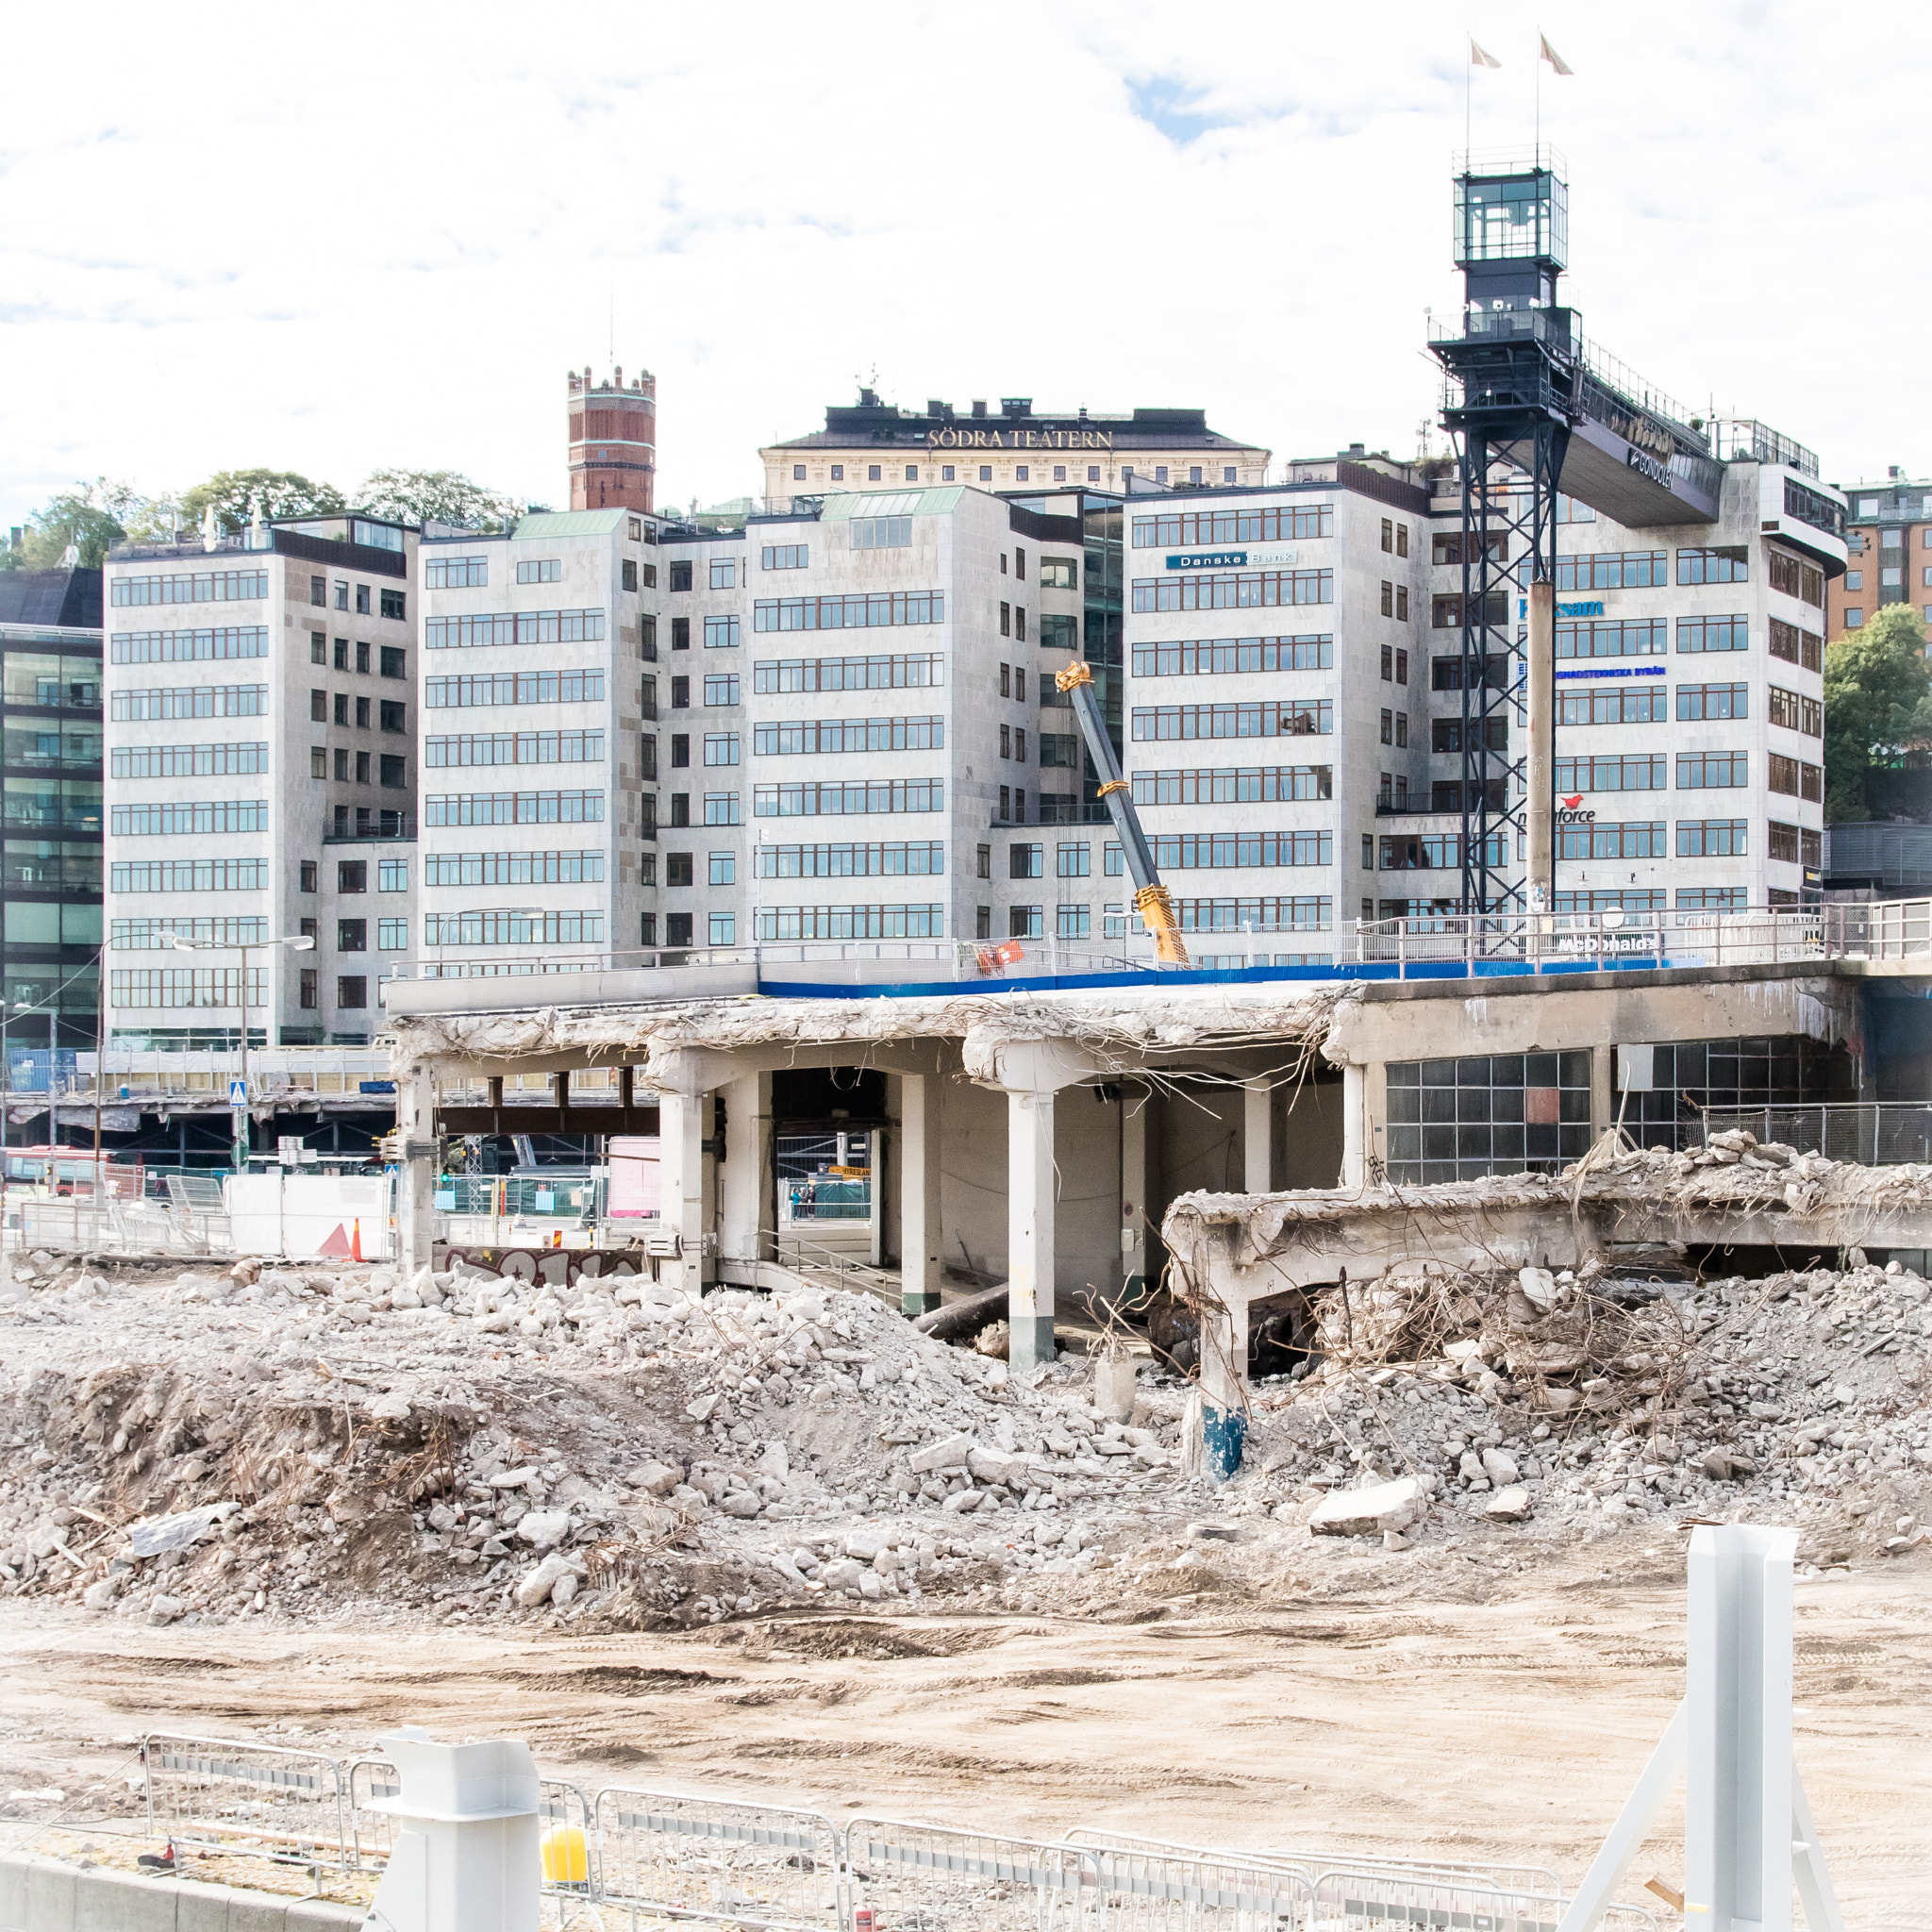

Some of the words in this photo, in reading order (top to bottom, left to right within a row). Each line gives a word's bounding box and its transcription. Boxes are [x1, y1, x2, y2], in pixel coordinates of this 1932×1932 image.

[928, 427, 1003, 448] SÖDRA
[1009, 430, 1113, 448] TEATERN
[1640, 454, 1674, 489] GONDOLEN
[1181, 556, 1241, 567] Danske
[1252, 553, 1292, 563] Bank
[1519, 599, 1603, 619] Fsam
[1518, 807, 1595, 824] nforce
[1558, 937, 1658, 952] McDonald's
[842, 1168, 872, 1176] HYRESLAN
